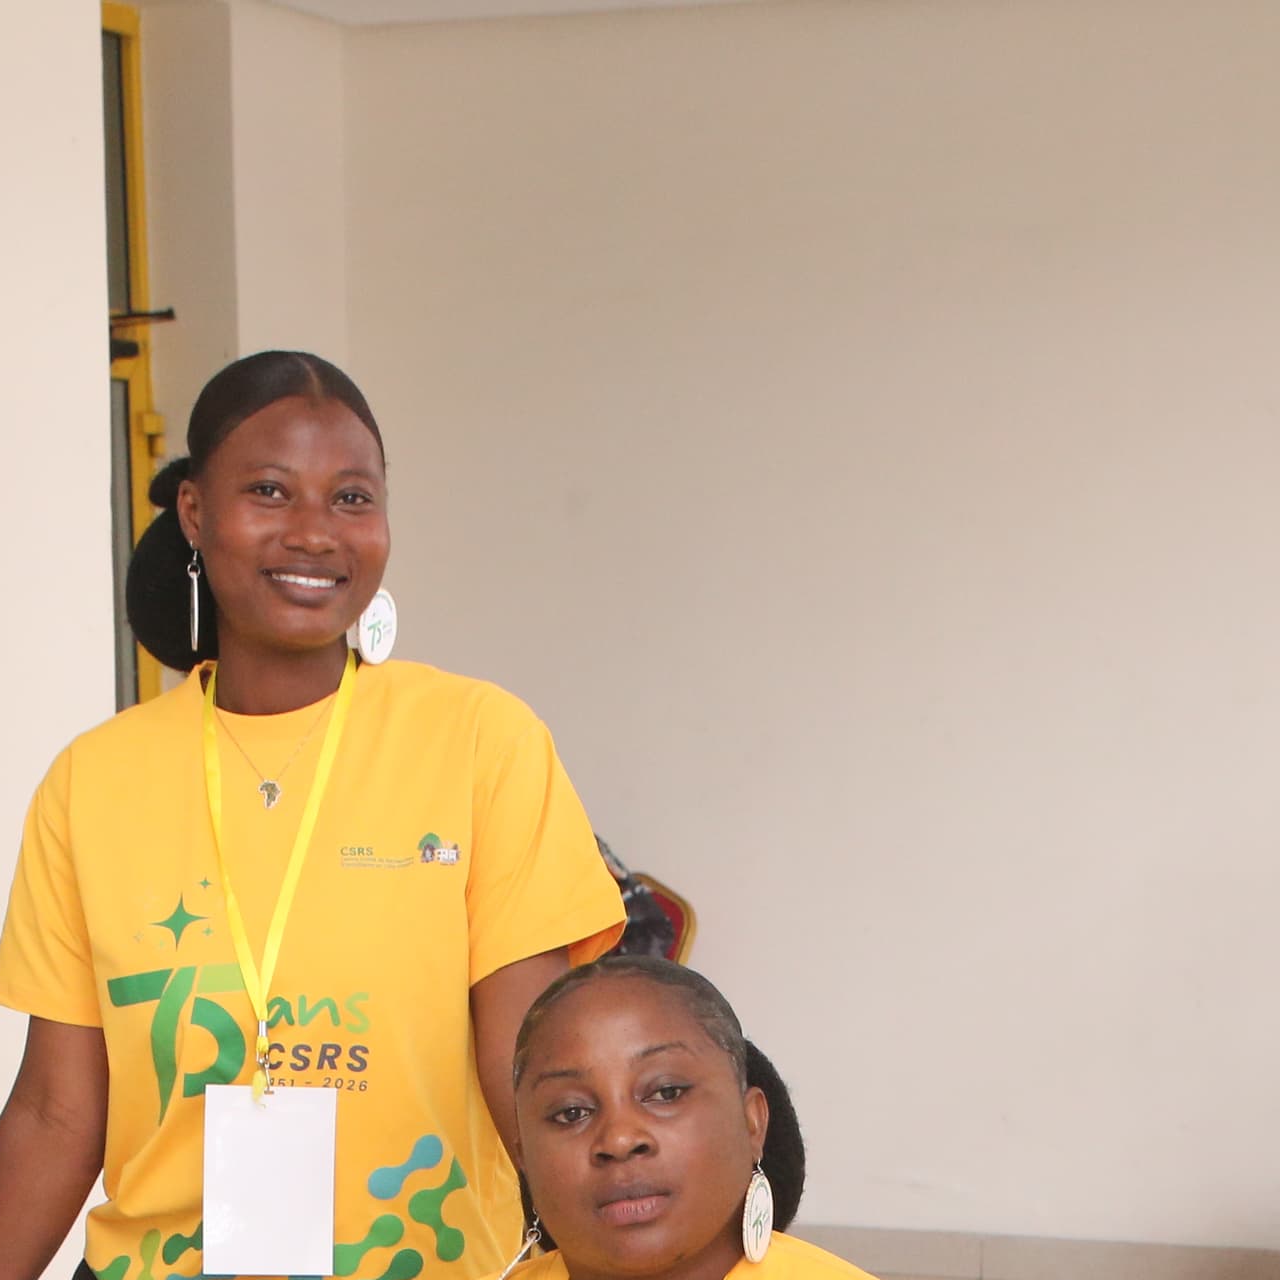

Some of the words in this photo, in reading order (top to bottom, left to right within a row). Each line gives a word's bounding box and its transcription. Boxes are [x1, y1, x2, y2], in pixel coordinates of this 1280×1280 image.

[340, 846, 373, 857] CSRS
[267, 991, 370, 1034] ans
[266, 1043, 370, 1074] CSRS
[323, 1077, 368, 1092] 2026
